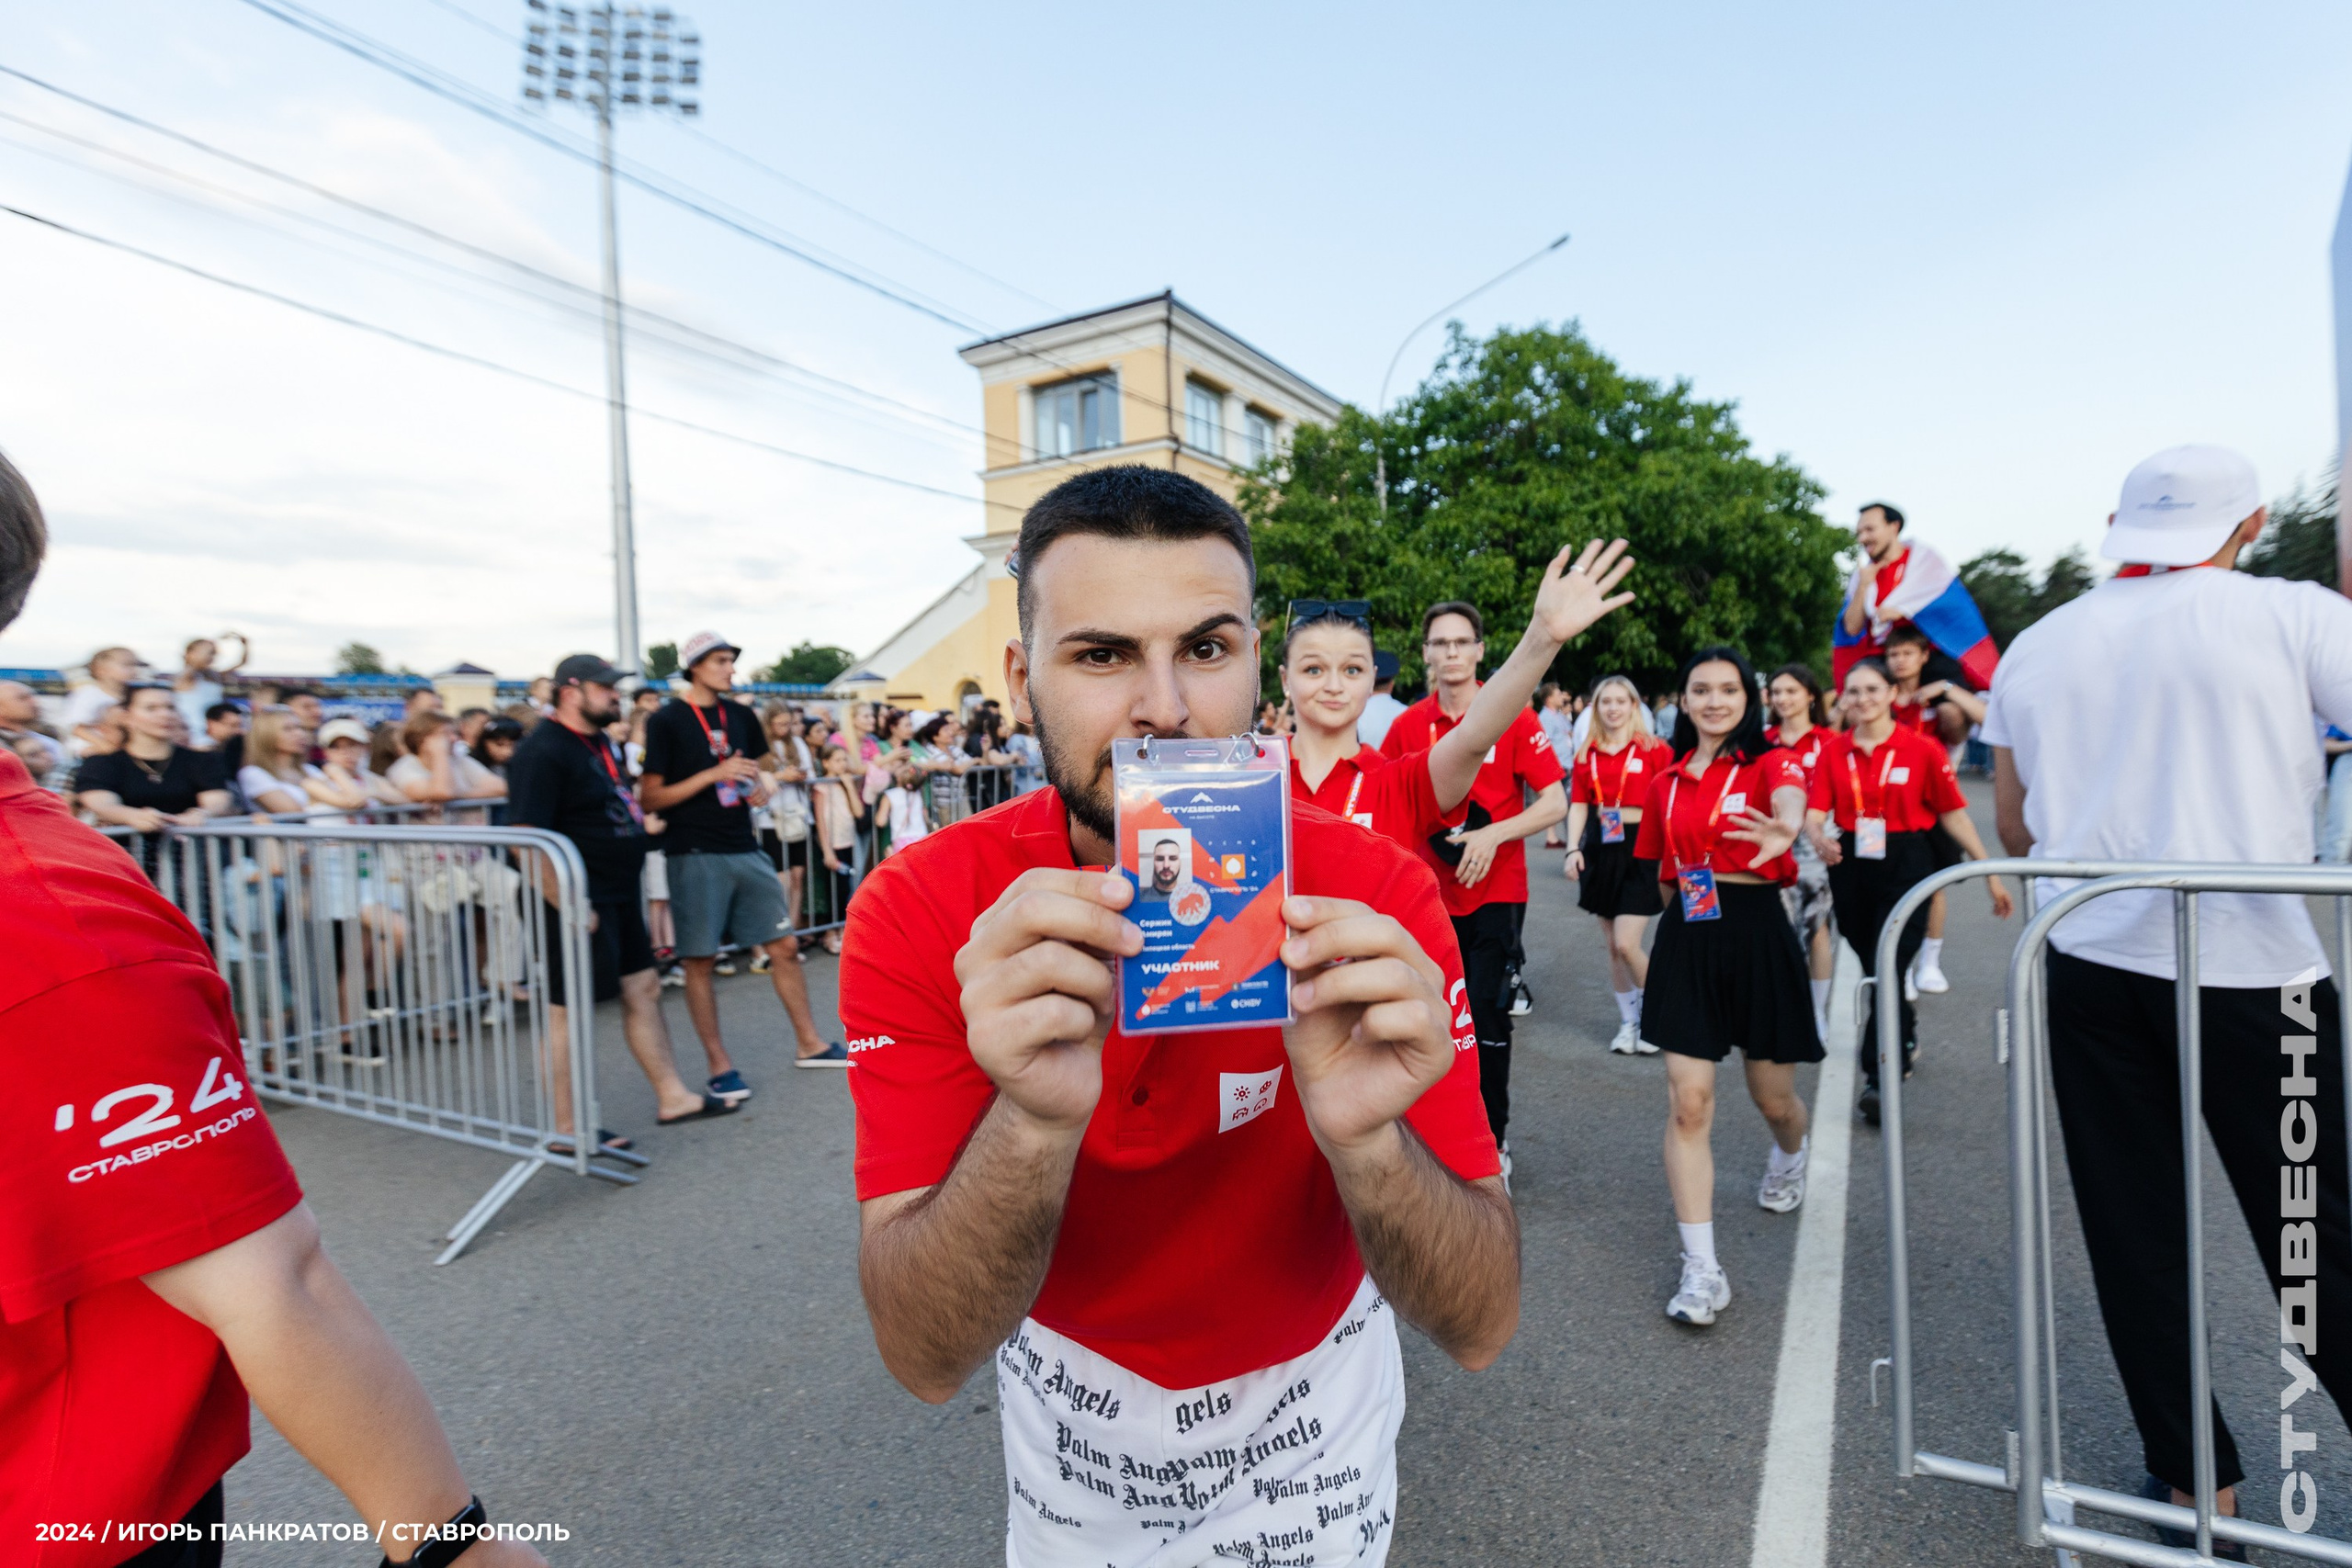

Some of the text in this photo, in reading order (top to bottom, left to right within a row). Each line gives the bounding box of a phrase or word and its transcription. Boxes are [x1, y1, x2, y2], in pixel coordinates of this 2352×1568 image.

[1161, 805, 1241, 814] СТУДВЕСНА
[1141, 960, 1220, 975] УЧАСТНИК
[54, 1056, 244, 1148] '24
[67, 1107, 256, 1183] СТАВРОПОЛЬ
[1044, 1359, 1122, 1421] Angels
[1175, 1388, 1232, 1435] gels
[1057, 1420, 1112, 1470] Palm
[1166, 1448, 1237, 1482] Palm
[1056, 1454, 1115, 1499] Palm
[1267, 1466, 1361, 1506] Palm Angels
[1014, 1477, 1082, 1528] Palm Angels
[1317, 1501, 1353, 1529] Palm
[1140, 1519, 1174, 1529] Palm
[1257, 1526, 1314, 1551] Angels
